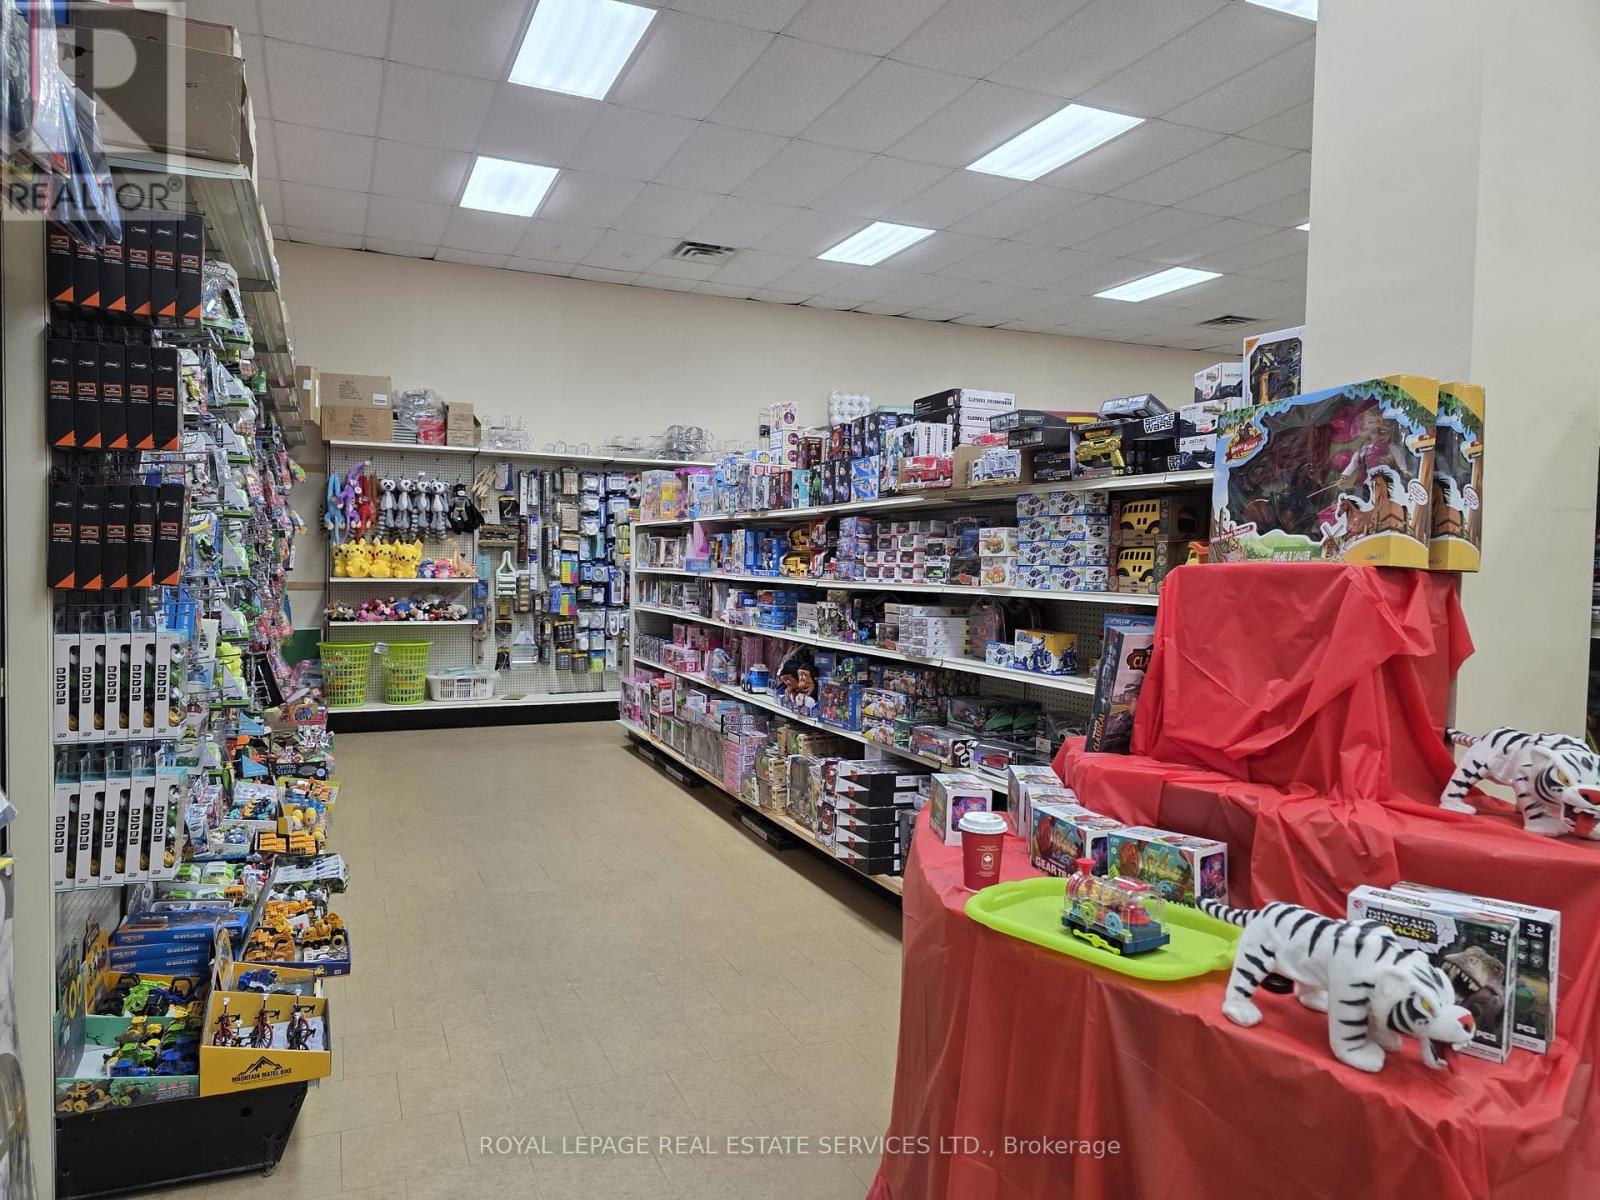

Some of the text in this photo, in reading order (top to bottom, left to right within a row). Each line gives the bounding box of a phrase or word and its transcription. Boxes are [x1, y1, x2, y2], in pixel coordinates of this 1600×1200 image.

[1145, 413, 1174, 425] SPACE
[1035, 856, 1057, 875] GEAR
[1368, 908, 1438, 933] DINOSAUR
